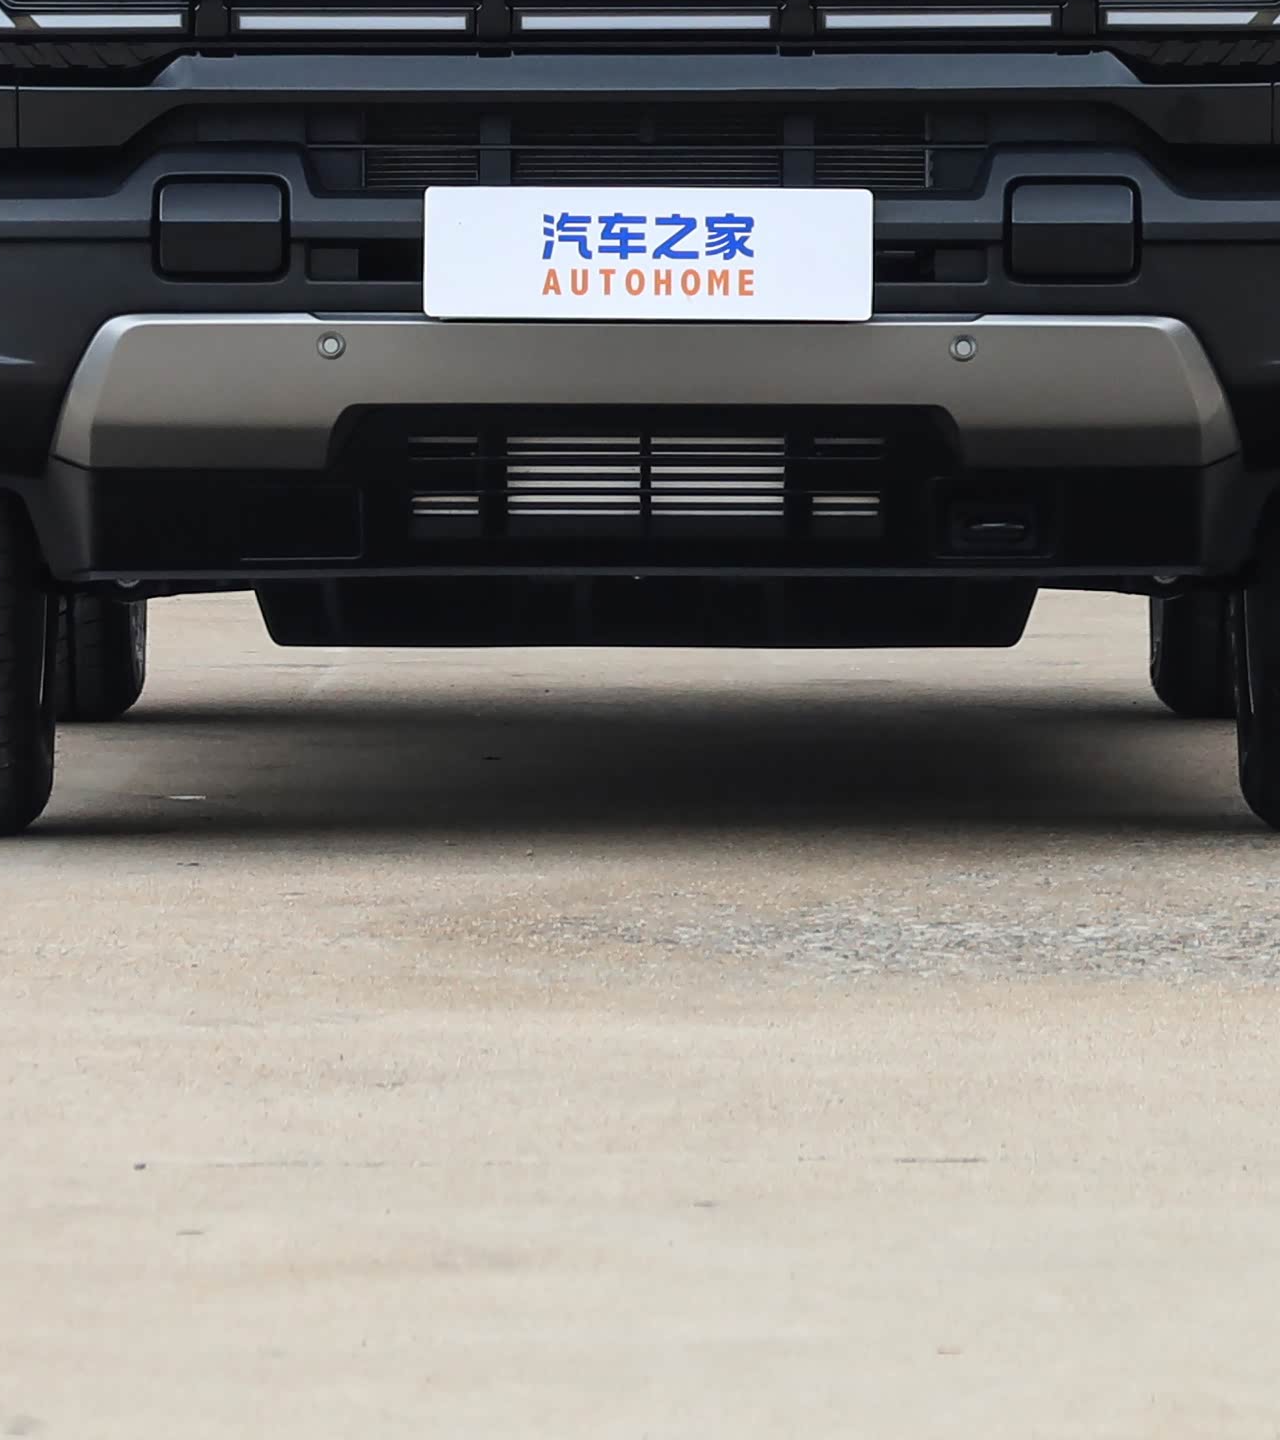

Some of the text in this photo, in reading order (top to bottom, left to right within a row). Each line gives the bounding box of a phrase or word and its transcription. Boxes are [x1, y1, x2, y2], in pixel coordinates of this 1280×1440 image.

[542, 212, 755, 261] 汽车之家
[542, 268, 755, 296] AUTOHOME
